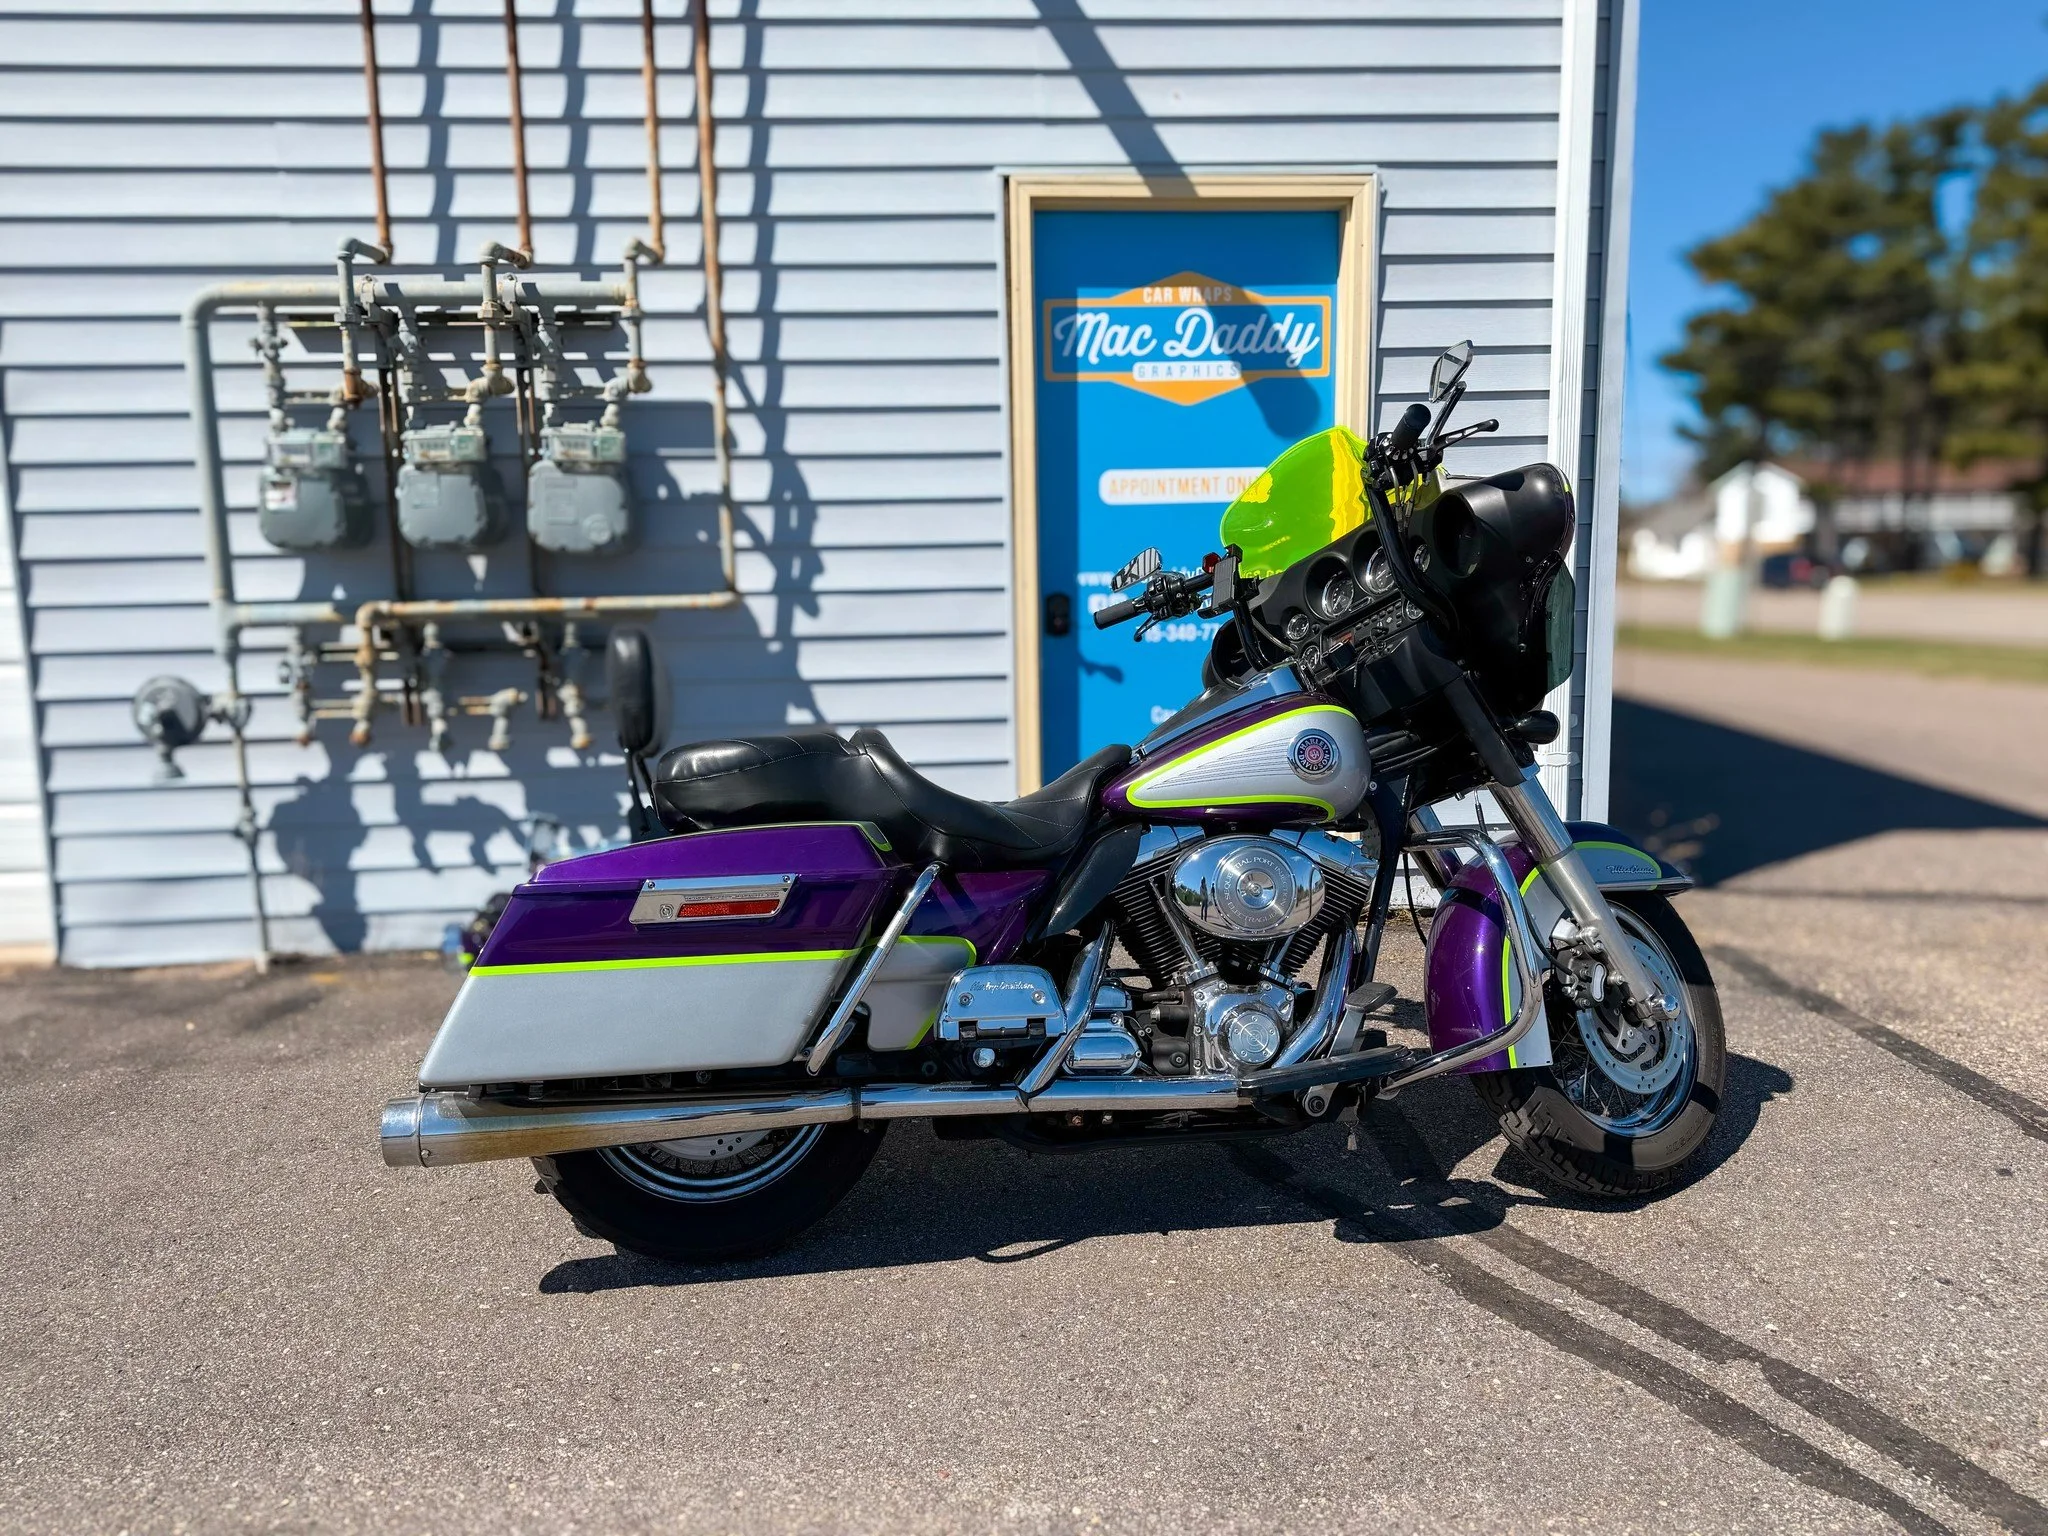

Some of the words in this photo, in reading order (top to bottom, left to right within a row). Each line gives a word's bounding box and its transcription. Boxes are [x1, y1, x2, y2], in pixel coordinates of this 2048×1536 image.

[1143, 286, 1173, 303] CAR
[1178, 286, 1232, 303] WRAPS
[1053, 310, 1157, 365] Mac
[1163, 307, 1321, 368] Daddy
[1137, 362, 1238, 378] GRAPHICS
[1108, 476, 1221, 496] APPOINTMENT
[1226, 475, 1260, 495] ON
[1300, 738, 1329, 751] HARLEY
[1298, 754, 1330, 770] DAVIDSON
[1223, 857, 1252, 900] SEQUETIAL
[1253, 856, 1275, 867] PORT
